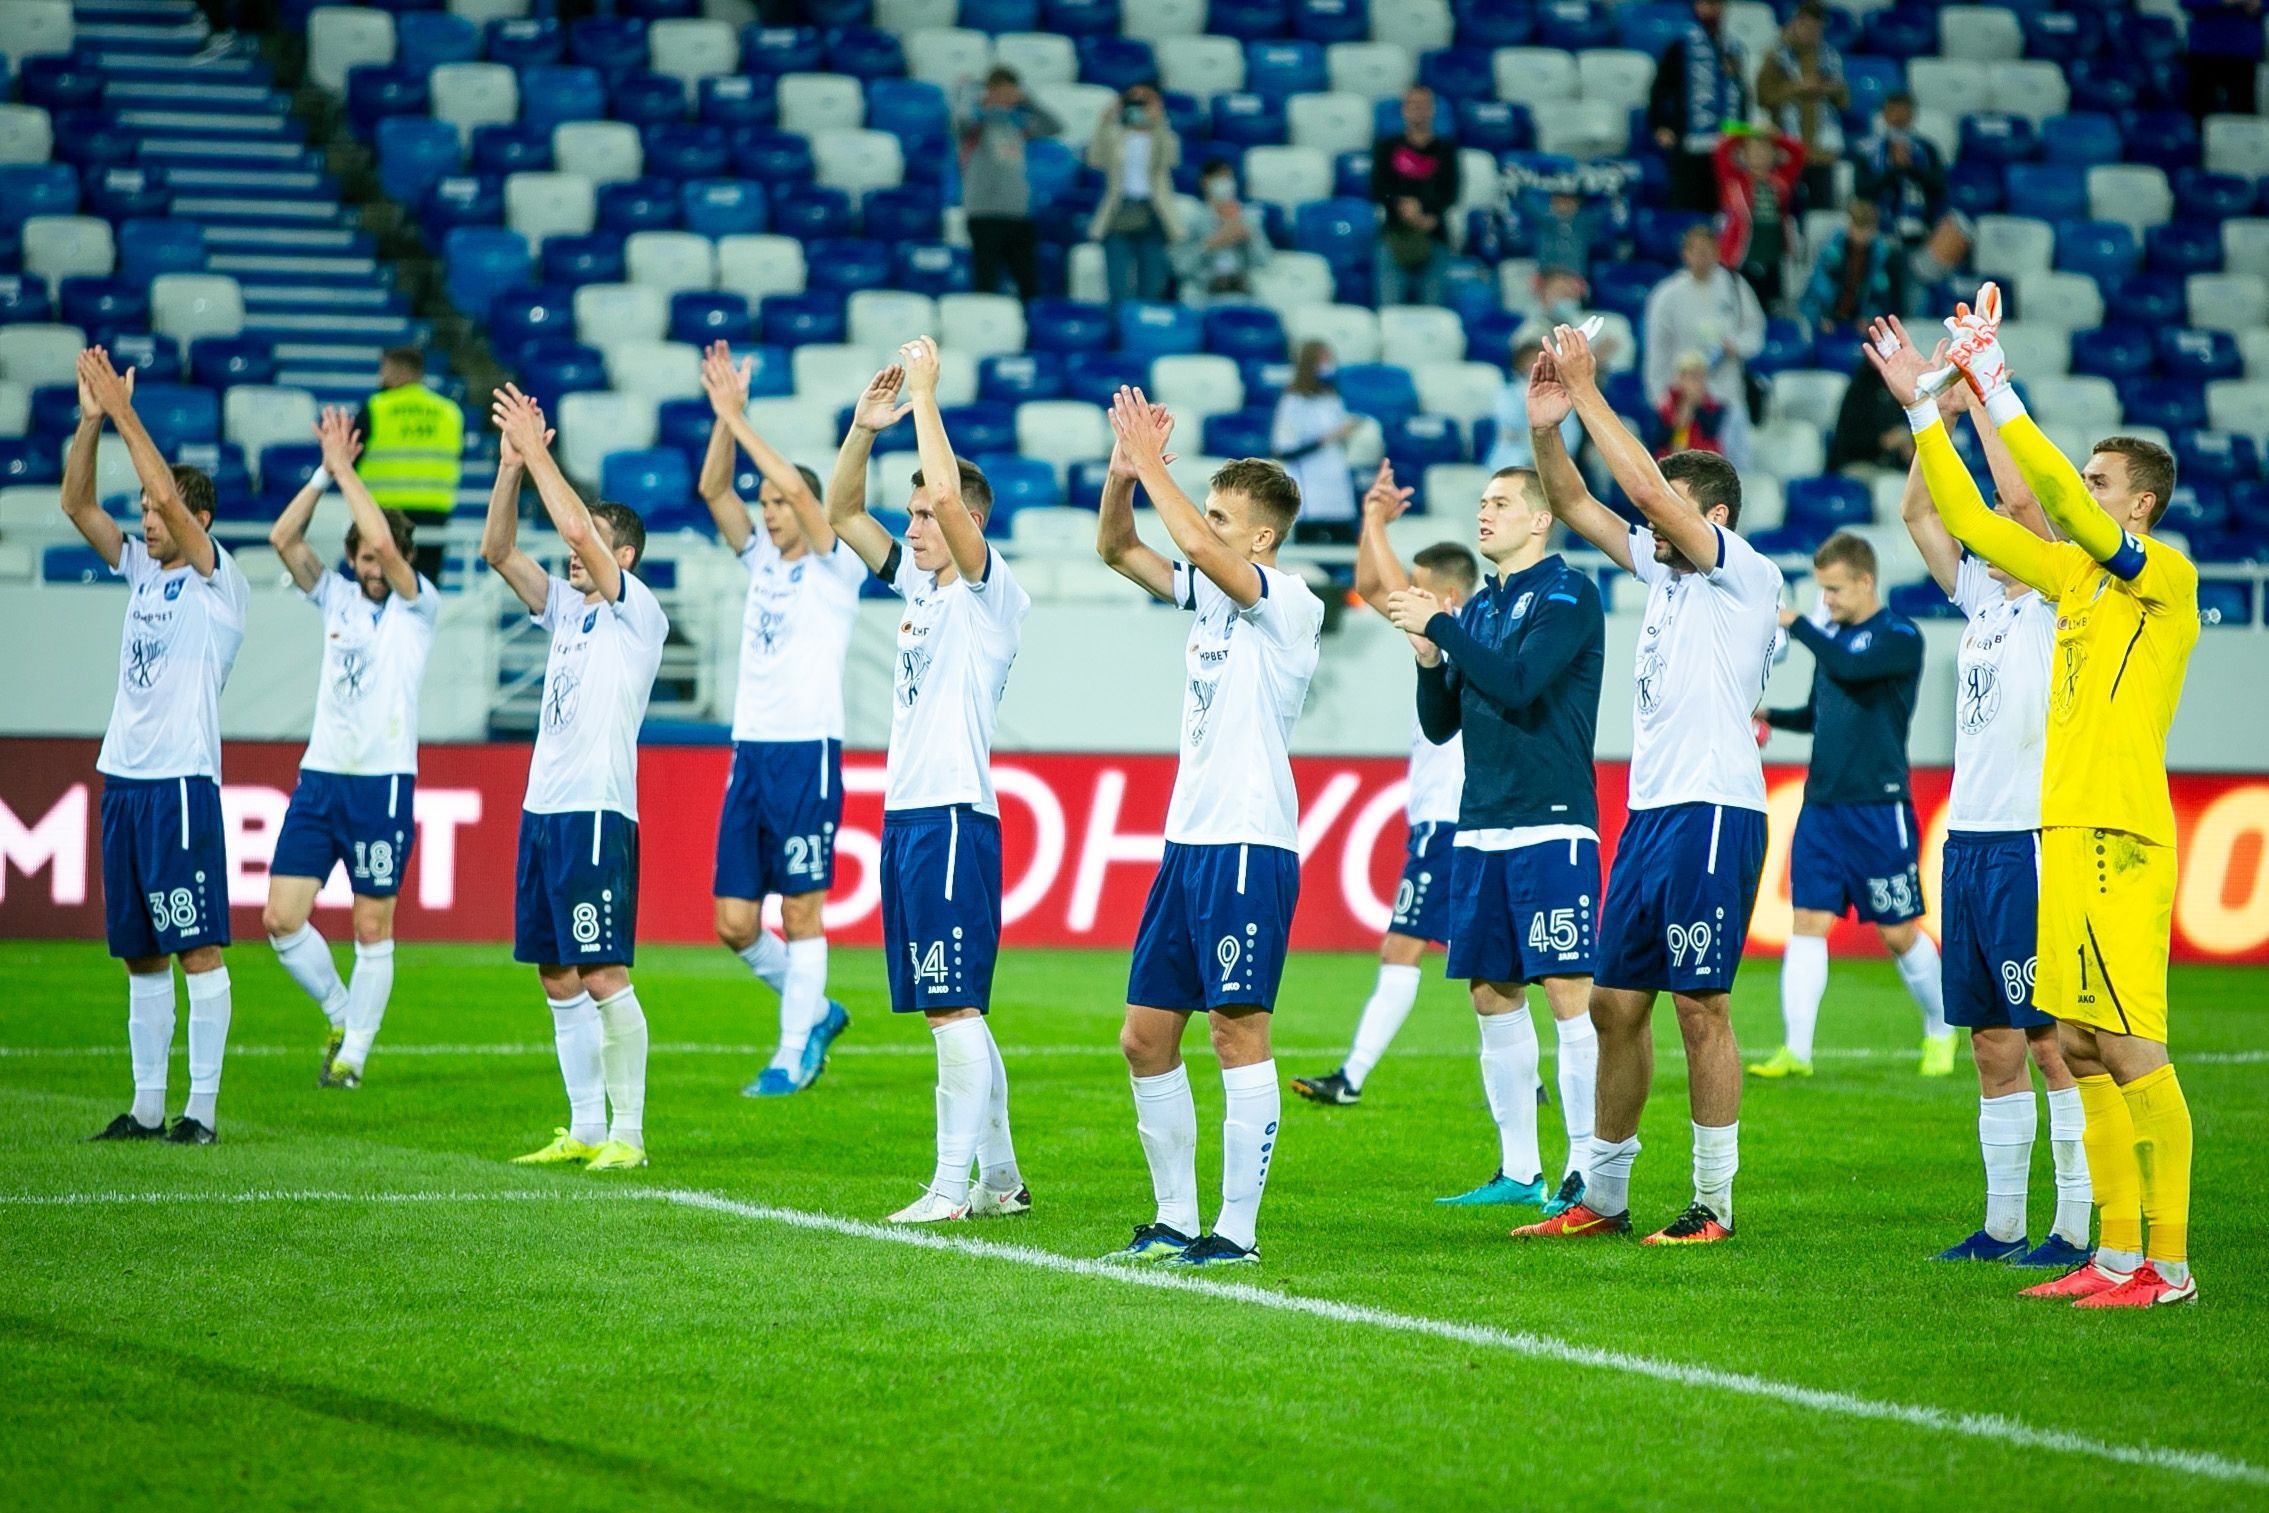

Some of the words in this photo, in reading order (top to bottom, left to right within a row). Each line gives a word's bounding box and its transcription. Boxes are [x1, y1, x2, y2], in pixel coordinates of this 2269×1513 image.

[0, 783, 483, 911] MBT
[354, 840, 394, 879] 18
[784, 834, 823, 876] 21
[148, 887, 197, 932] 38
[1867, 873, 1912, 914] 33
[572, 902, 600, 943] 8
[1528, 908, 1579, 953] 45
[1666, 921, 1712, 967] 99
[1216, 934, 1241, 982] 9
[2077, 943, 2088, 991] 1
[927, 985, 950, 995] JAKO
